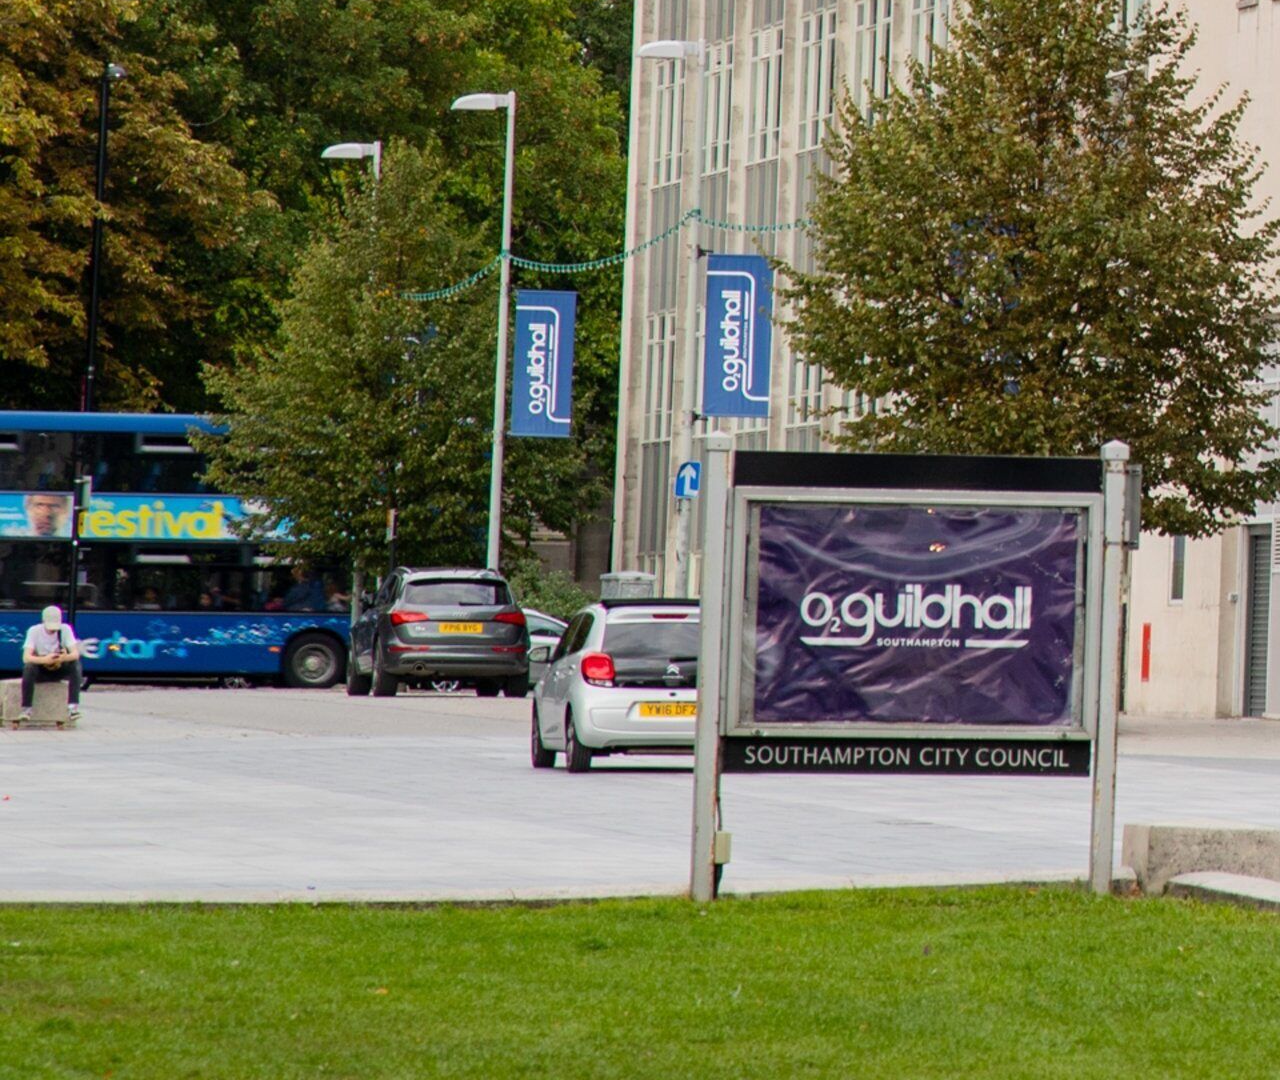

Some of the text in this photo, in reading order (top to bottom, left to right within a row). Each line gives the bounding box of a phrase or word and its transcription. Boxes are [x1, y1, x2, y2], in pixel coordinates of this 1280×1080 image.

[876, 638, 960, 648] SOUTHAMPTON
[744, 745, 1070, 768] SOUTHAMPTON CITY COUNCIL
